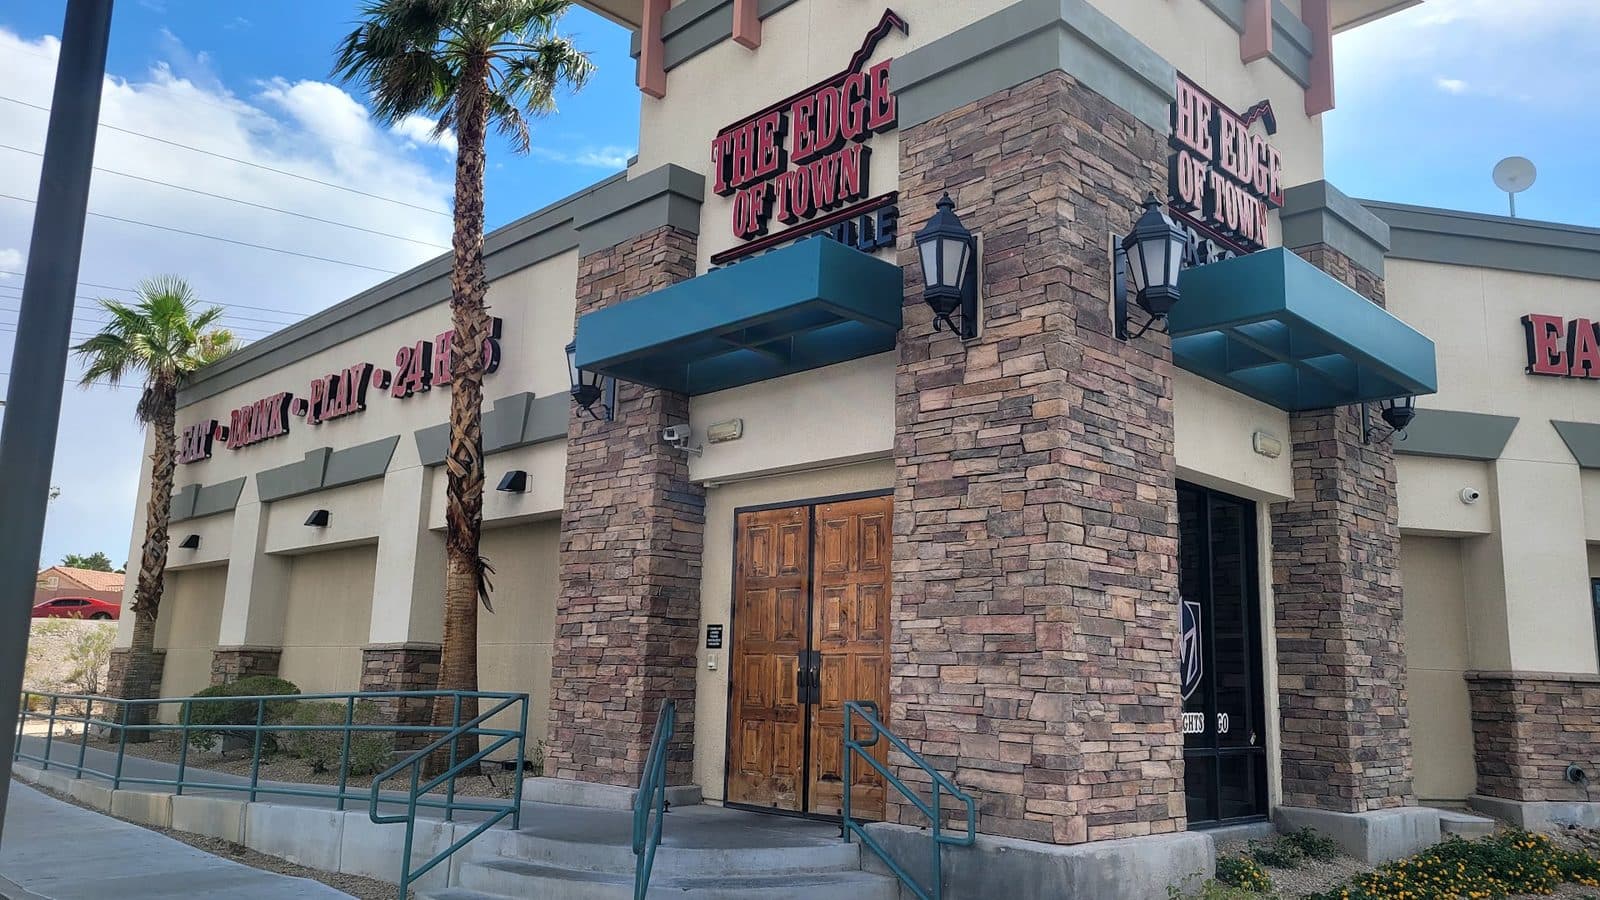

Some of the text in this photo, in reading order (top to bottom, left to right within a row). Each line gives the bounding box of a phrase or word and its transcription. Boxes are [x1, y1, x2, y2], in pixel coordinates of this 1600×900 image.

[711, 57, 897, 195] THE EDGE
[1168, 79, 1284, 206] HE EDGE
[732, 143, 865, 239] OF TOWN
[1177, 150, 1208, 210] OF
[1210, 170, 1269, 247] TOWN
[1521, 313, 1600, 379] EA
[177, 420, 216, 465] EAT
[227, 392, 291, 450] DRINK
[307, 362, 371, 425] PLAY
[391, 340, 429, 398] 24
[1182, 712, 1204, 733] GHTS
